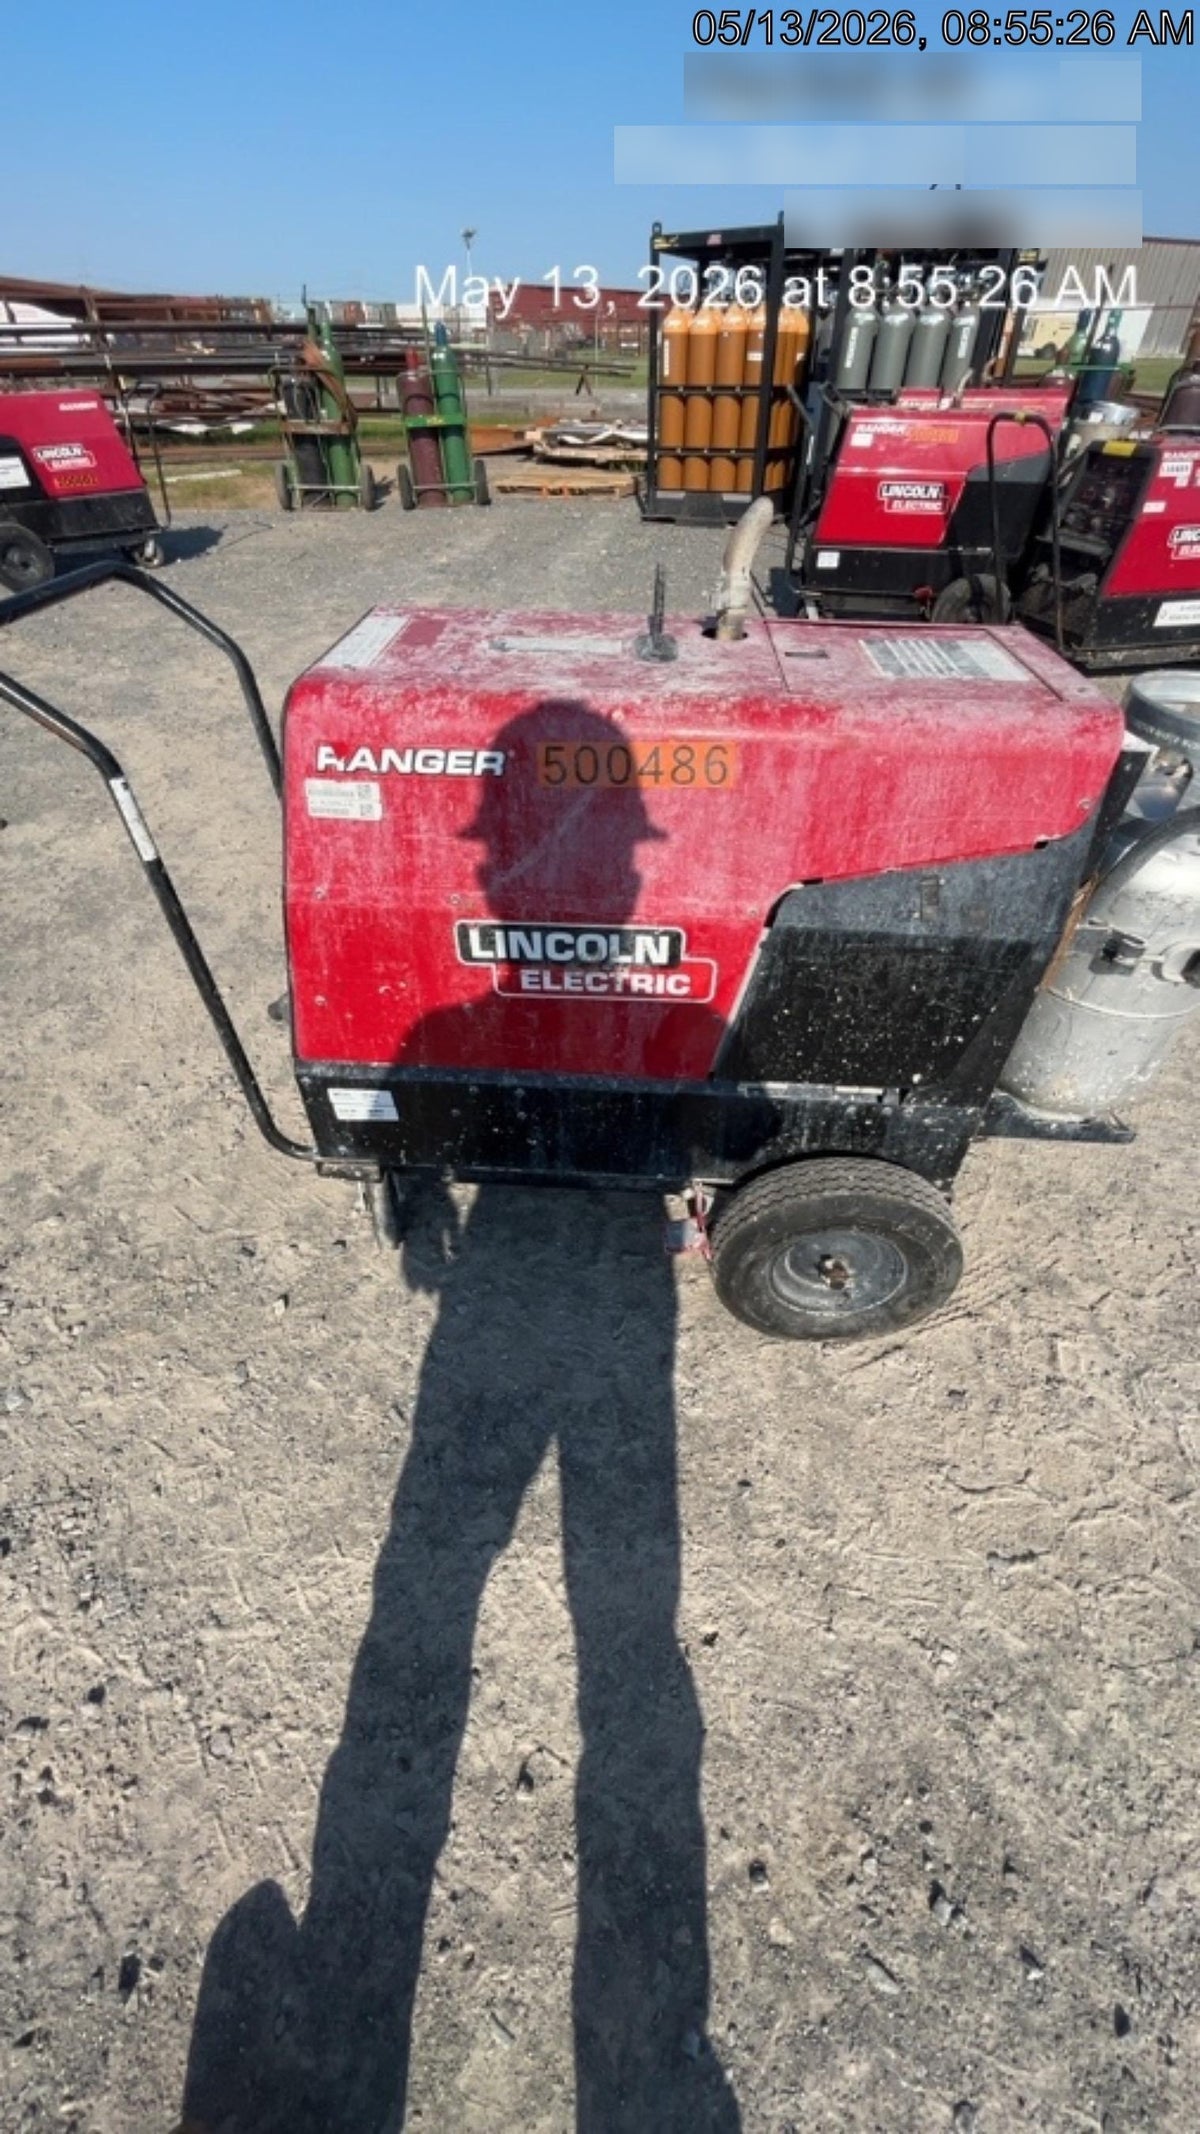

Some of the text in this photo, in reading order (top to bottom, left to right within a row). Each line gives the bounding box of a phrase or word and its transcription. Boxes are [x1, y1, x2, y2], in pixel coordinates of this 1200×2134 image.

[881, 483, 940, 499] LINCOLN
[891, 500, 943, 512] ELECTRIC
[544, 744, 728, 786] 500486
[468, 927, 671, 966] LINCOLN
[519, 967, 692, 996] ELECTRIC
